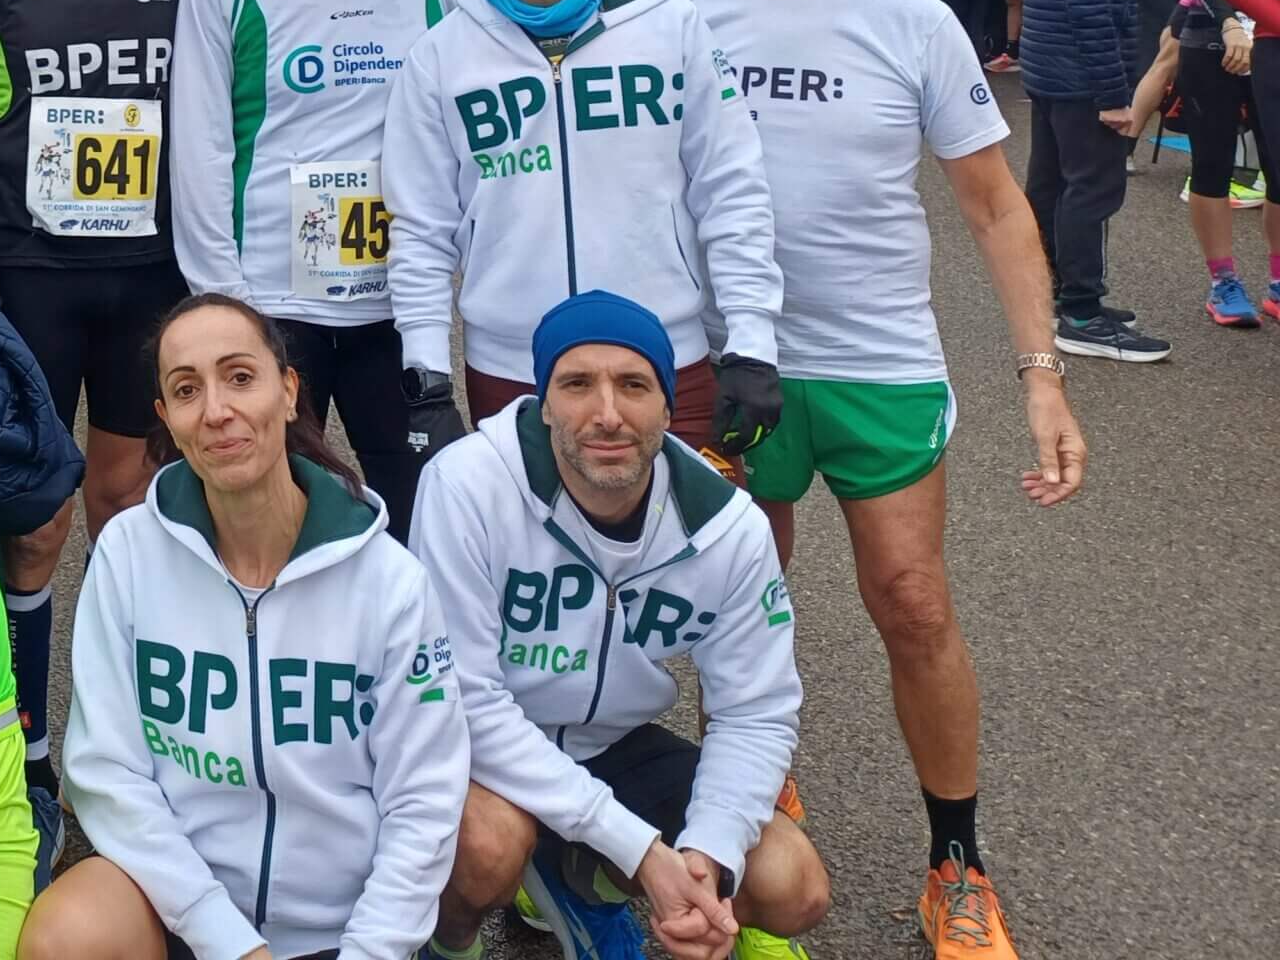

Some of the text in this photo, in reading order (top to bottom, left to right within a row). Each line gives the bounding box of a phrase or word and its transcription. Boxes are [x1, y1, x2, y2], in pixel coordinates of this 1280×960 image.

[332, 41, 383, 57] Circolo
[334, 57, 405, 74] Dipenden
[47, 108, 104, 124] BPER:
[76, 137, 151, 196] 641
[308, 172, 368, 189] BPER:
[80, 219, 130, 231] KARHU
[506, 643, 588, 674] anca
[136, 638, 375, 746] BPER:
[142, 719, 247, 787] Banca
